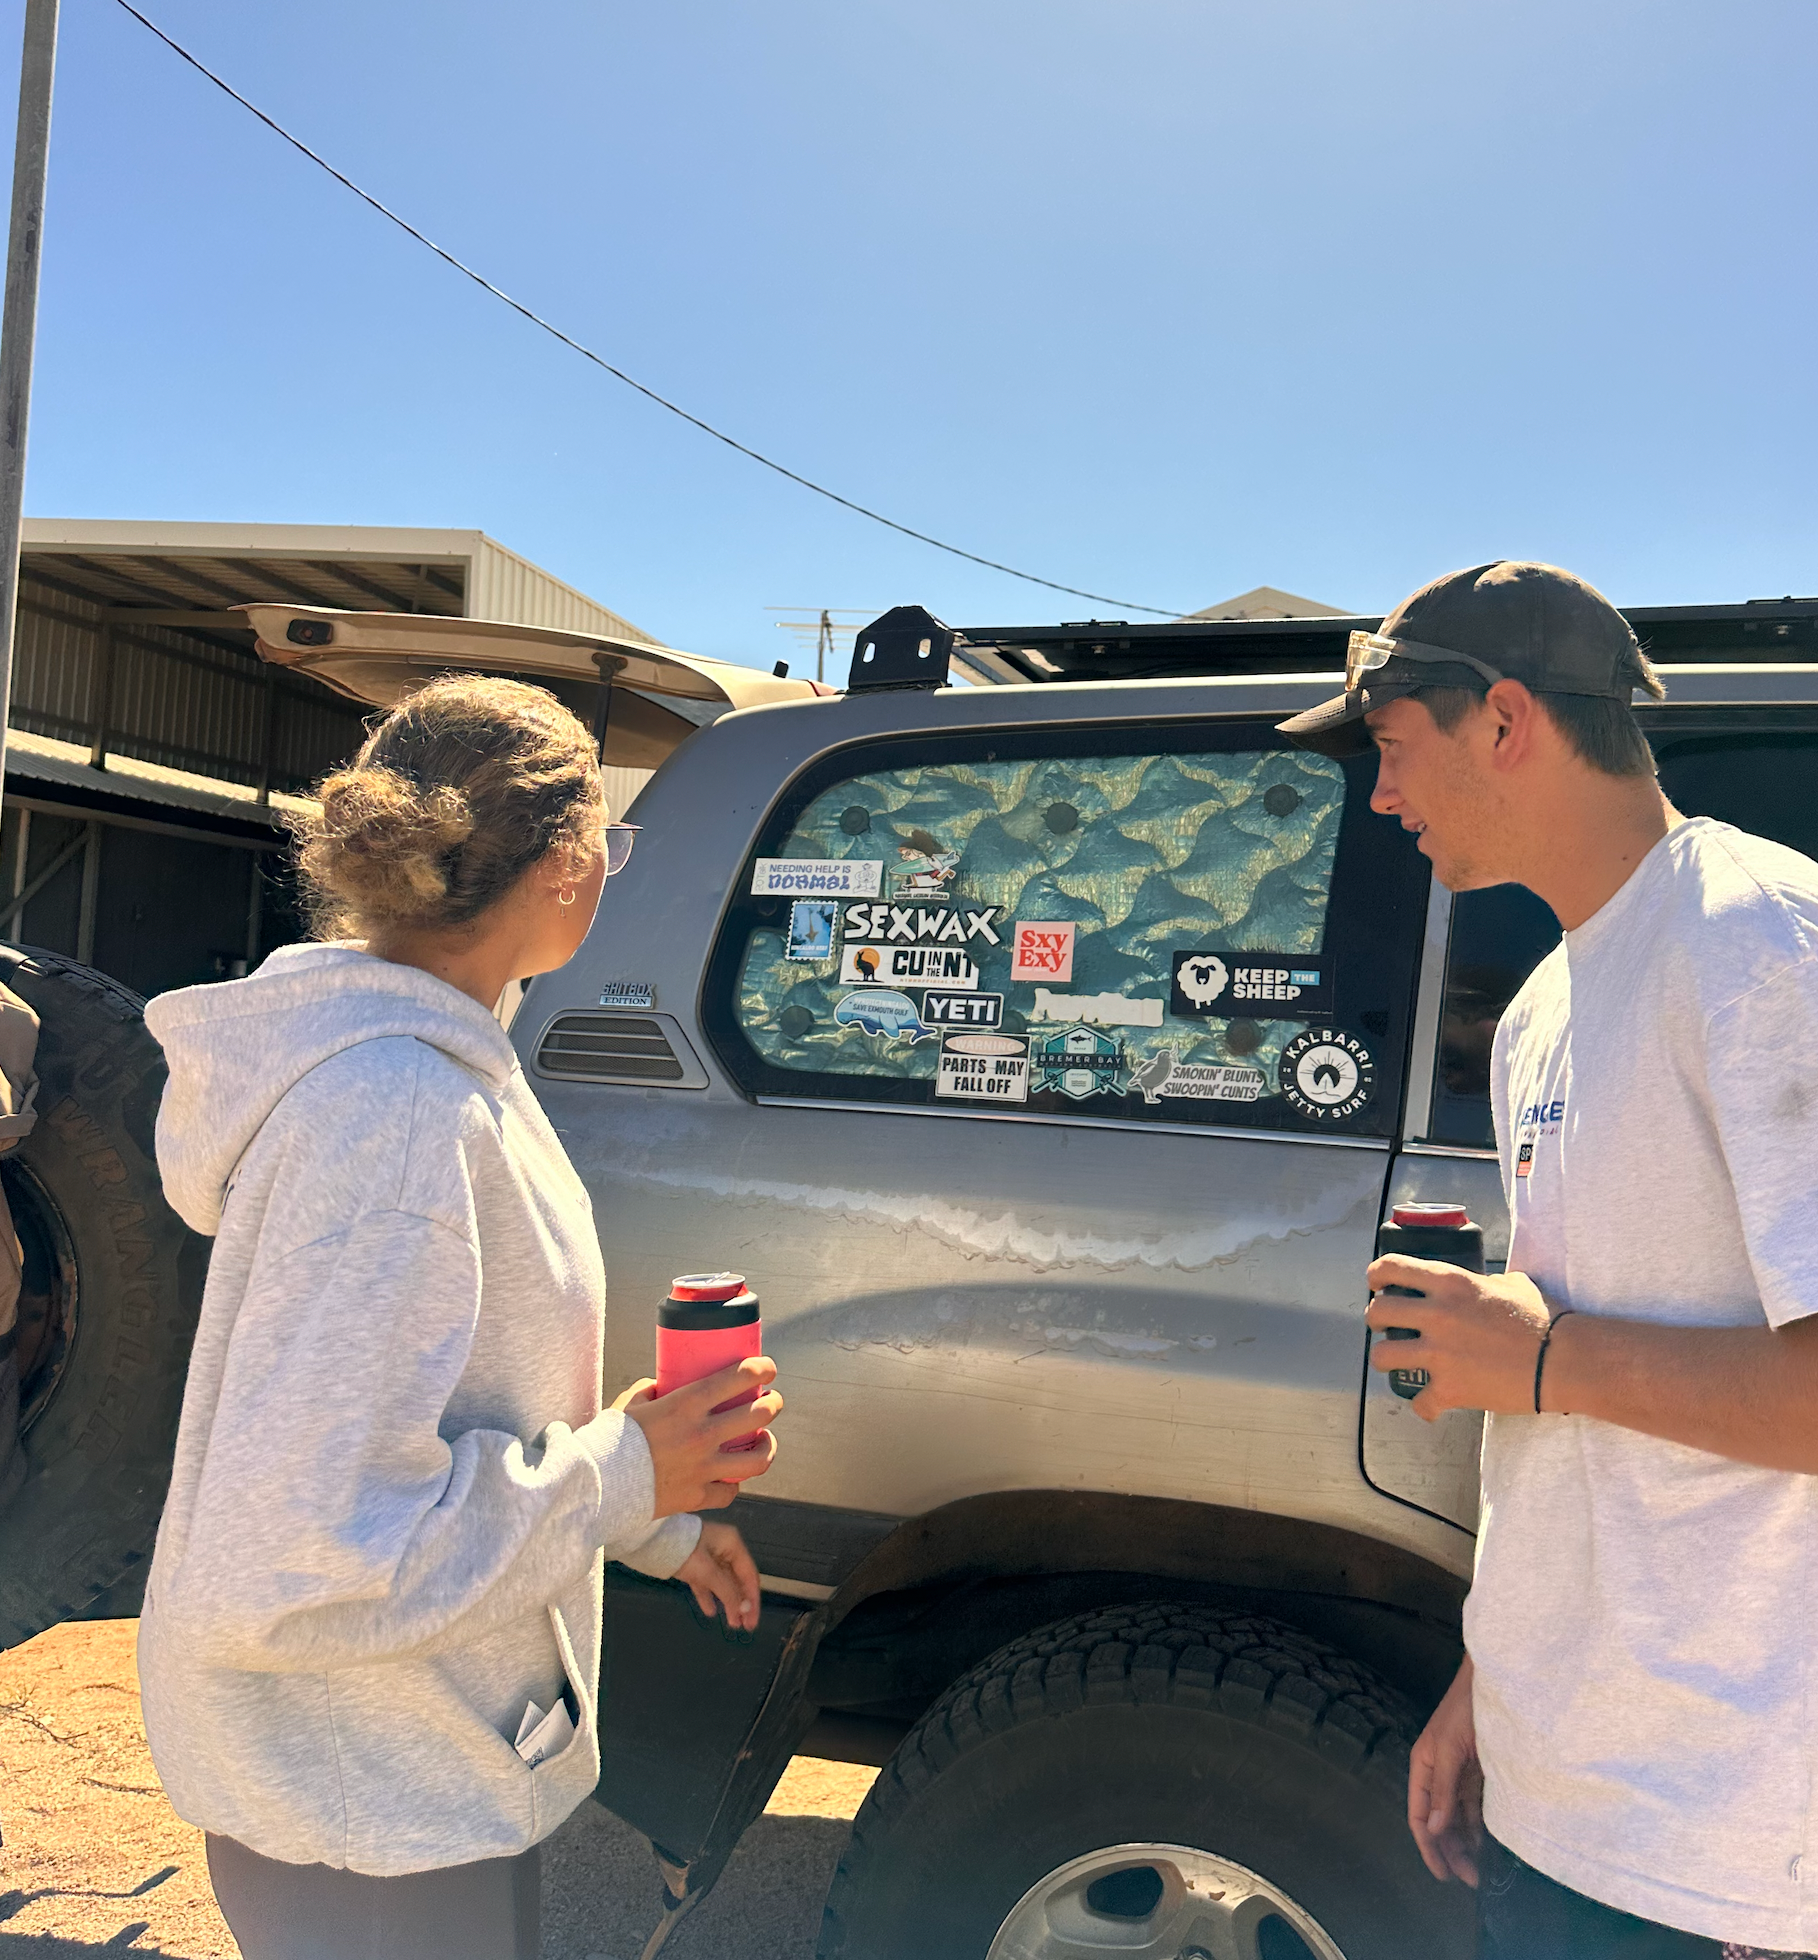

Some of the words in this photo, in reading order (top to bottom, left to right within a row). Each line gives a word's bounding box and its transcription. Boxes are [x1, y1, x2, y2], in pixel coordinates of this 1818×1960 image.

[769, 864, 813, 874] NEEDING
[815, 865, 840, 873] HELP
[842, 865, 851, 874] IS
[844, 902, 1000, 946] SEXWAX
[1020, 930, 1068, 953] Sxy
[892, 950, 925, 976] CU
[928, 951, 942, 966] IN
[1018, 949, 1067, 973] Exy
[926, 968, 940, 978] THE
[1234, 968, 1289, 984] KEEP
[1293, 974, 1315, 982] THE
[602, 982, 656, 996] SHITBOX
[1233, 983, 1301, 1000] SHEEP
[604, 997, 647, 1005] EDITION
[853, 1003, 867, 1011] SAVE
[868, 1006, 894, 1015] EXMOUTH
[894, 1008, 908, 1016] GULF
[929, 997, 994, 1022] YETI
[955, 1038, 1016, 1051] WARNING
[1286, 1030, 1373, 1069] KALBARRI
[942, 1057, 986, 1074] PARTS
[995, 1060, 1024, 1076] MAY
[1040, 1054, 1090, 1064] BREMER
[1098, 1056, 1122, 1065] BAY
[1172, 1067, 1221, 1080] SMOKIN'
[1223, 1070, 1263, 1083] BLUNTS
[954, 1076, 983, 1092] FALL
[986, 1078, 1011, 1094] OFF
[1163, 1083, 1219, 1096] SWOOPIN'
[1220, 1086, 1257, 1099] CUNTS
[1284, 1083, 1325, 1118] JETTY
[1332, 1089, 1367, 1118] SURF
[47, 1094, 160, 1465] WRANGLER
[1397, 1369, 1423, 1382] ETI
